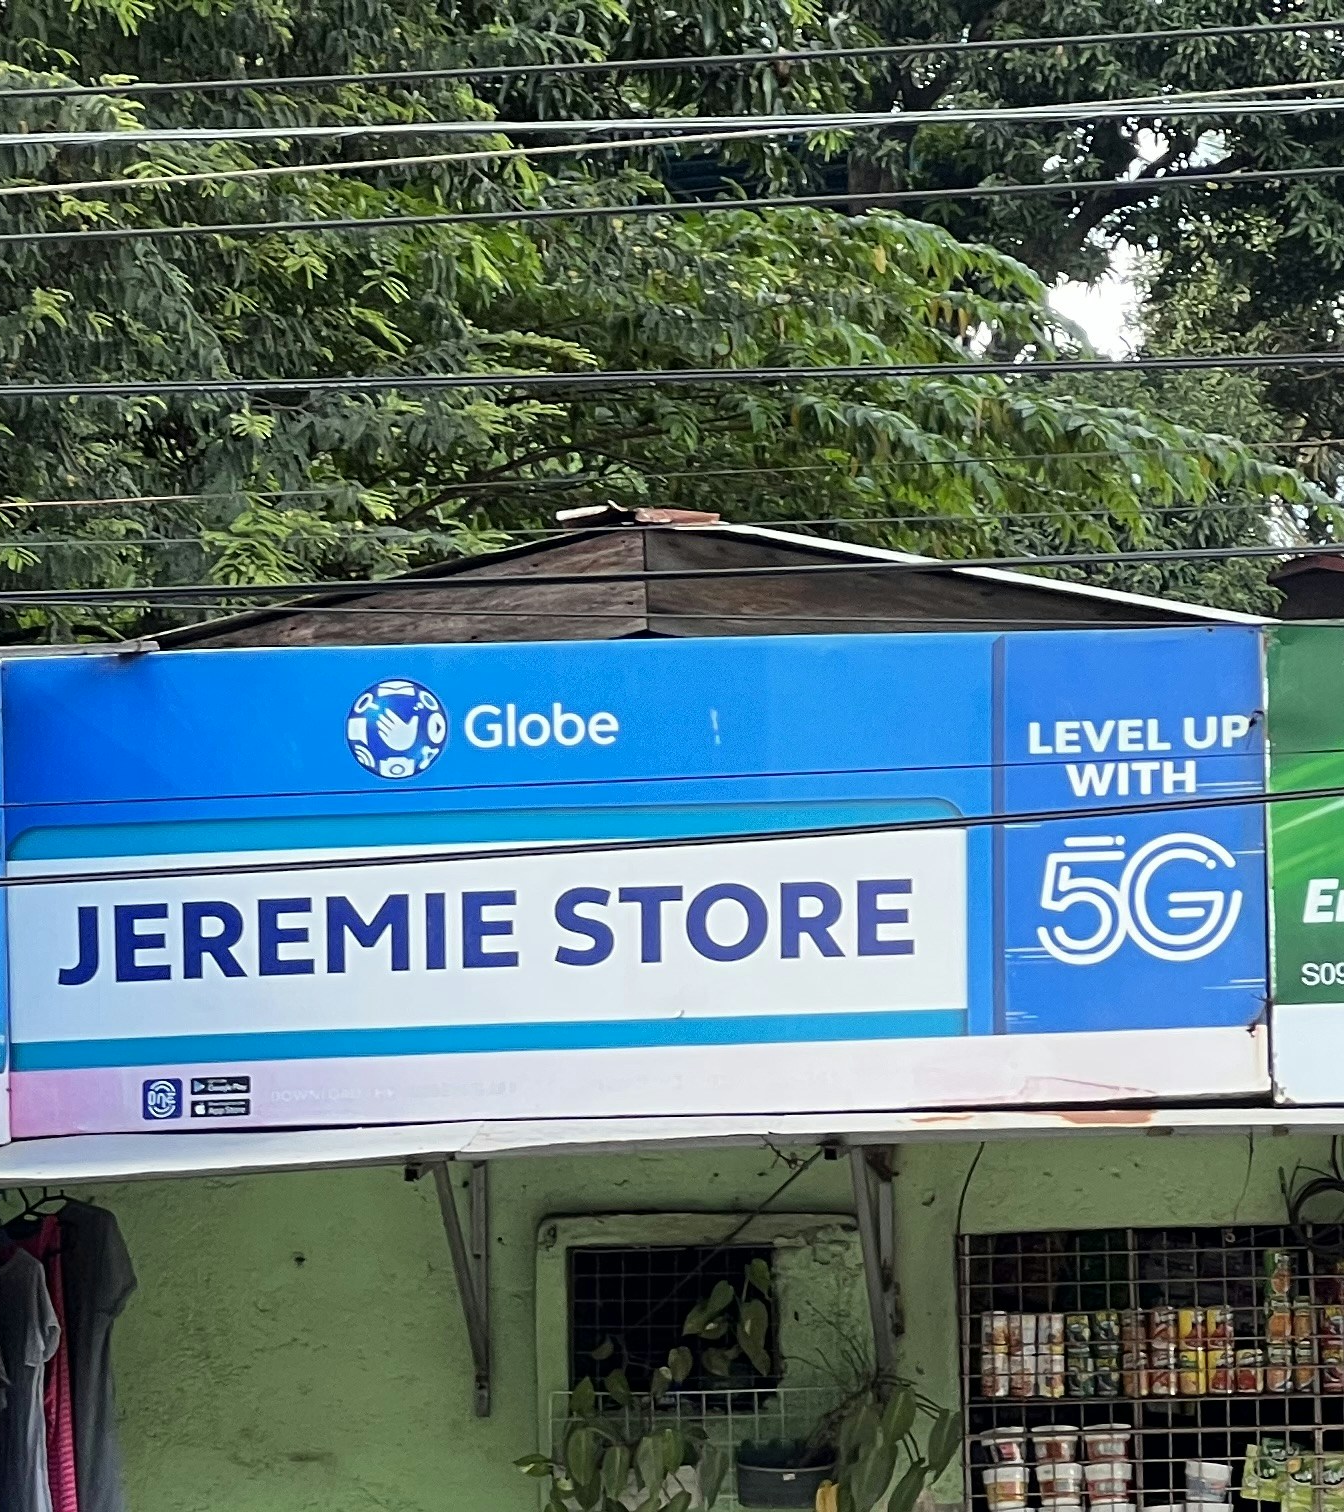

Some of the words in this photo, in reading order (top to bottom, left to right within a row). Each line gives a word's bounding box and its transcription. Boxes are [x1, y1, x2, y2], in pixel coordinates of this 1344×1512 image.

[465, 703, 619, 749] Globe
[1028, 719, 1171, 755] LEVEL
[1182, 714, 1251, 749] UP
[1065, 761, 1197, 798] WITH
[1036, 832, 1244, 966] 5G
[57, 889, 520, 986] JEREMIE
[554, 878, 915, 967] STORE
